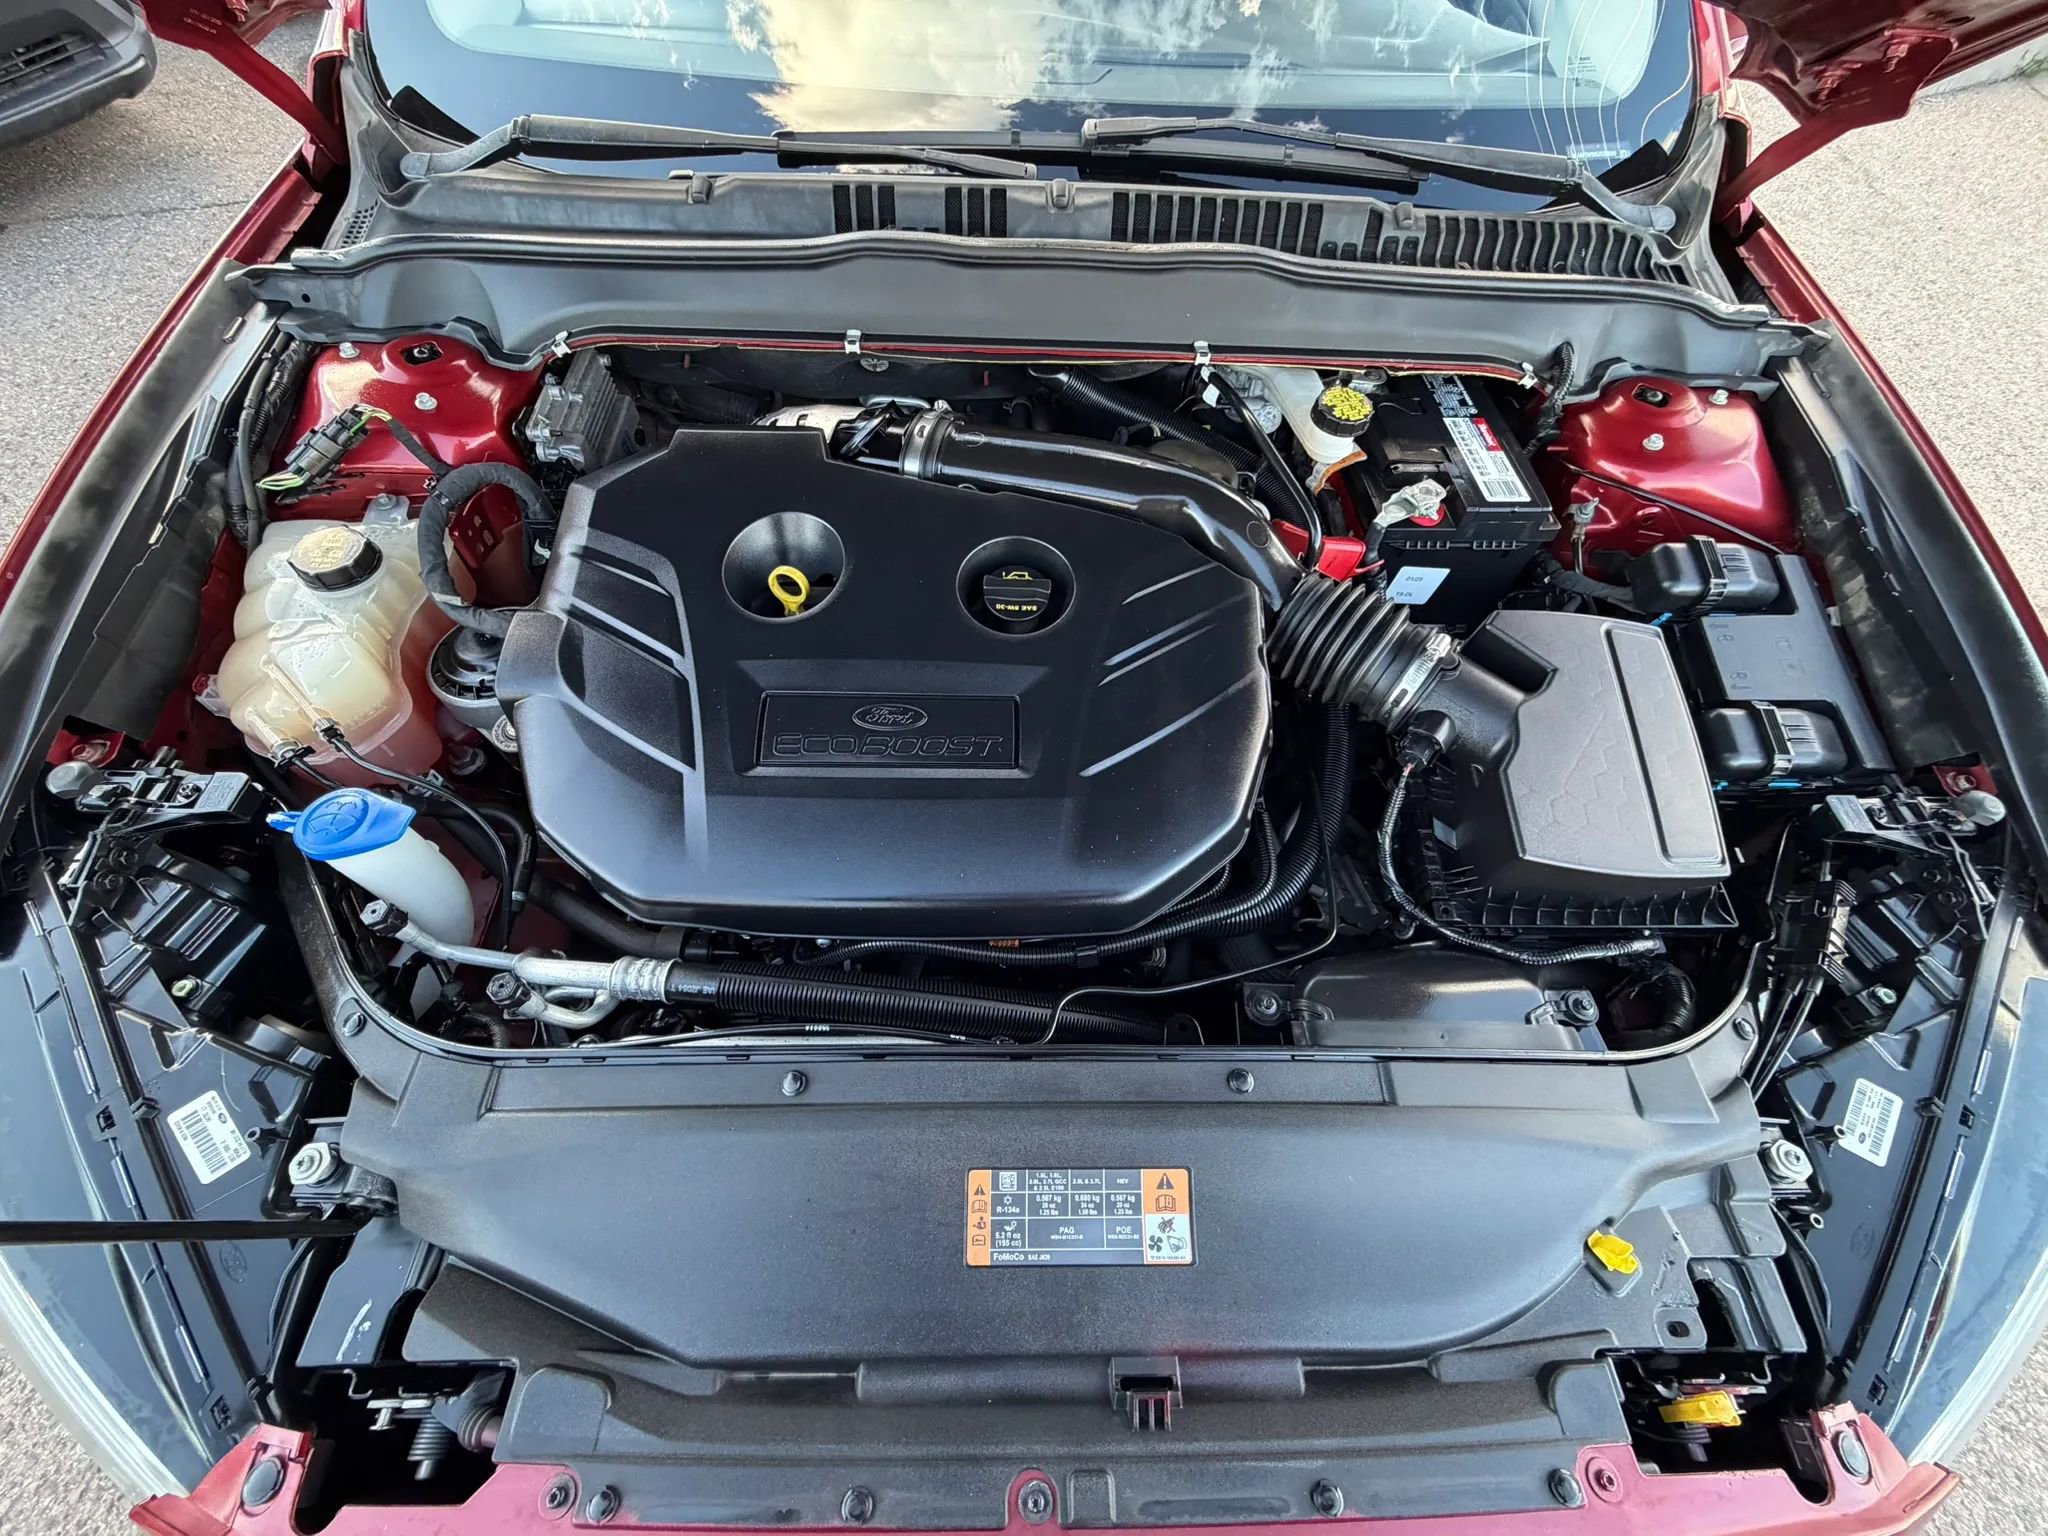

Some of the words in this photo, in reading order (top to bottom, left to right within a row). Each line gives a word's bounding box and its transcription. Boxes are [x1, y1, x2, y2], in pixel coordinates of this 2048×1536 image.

[995, 603, 1020, 611] 5W-30
[865, 706, 913, 724] Ford
[1053, 1194, 1062, 1203] kg
[1092, 1194, 1101, 1203] kg
[1127, 1194, 1136, 1203] kg
[996, 1206, 1020, 1214] R-134a
[1116, 1226, 1132, 1234] POE
[995, 1239, 1011, 1248] (155
[1011, 1239, 1022, 1248] cc)
[993, 1253, 1025, 1261] FoMoCo
